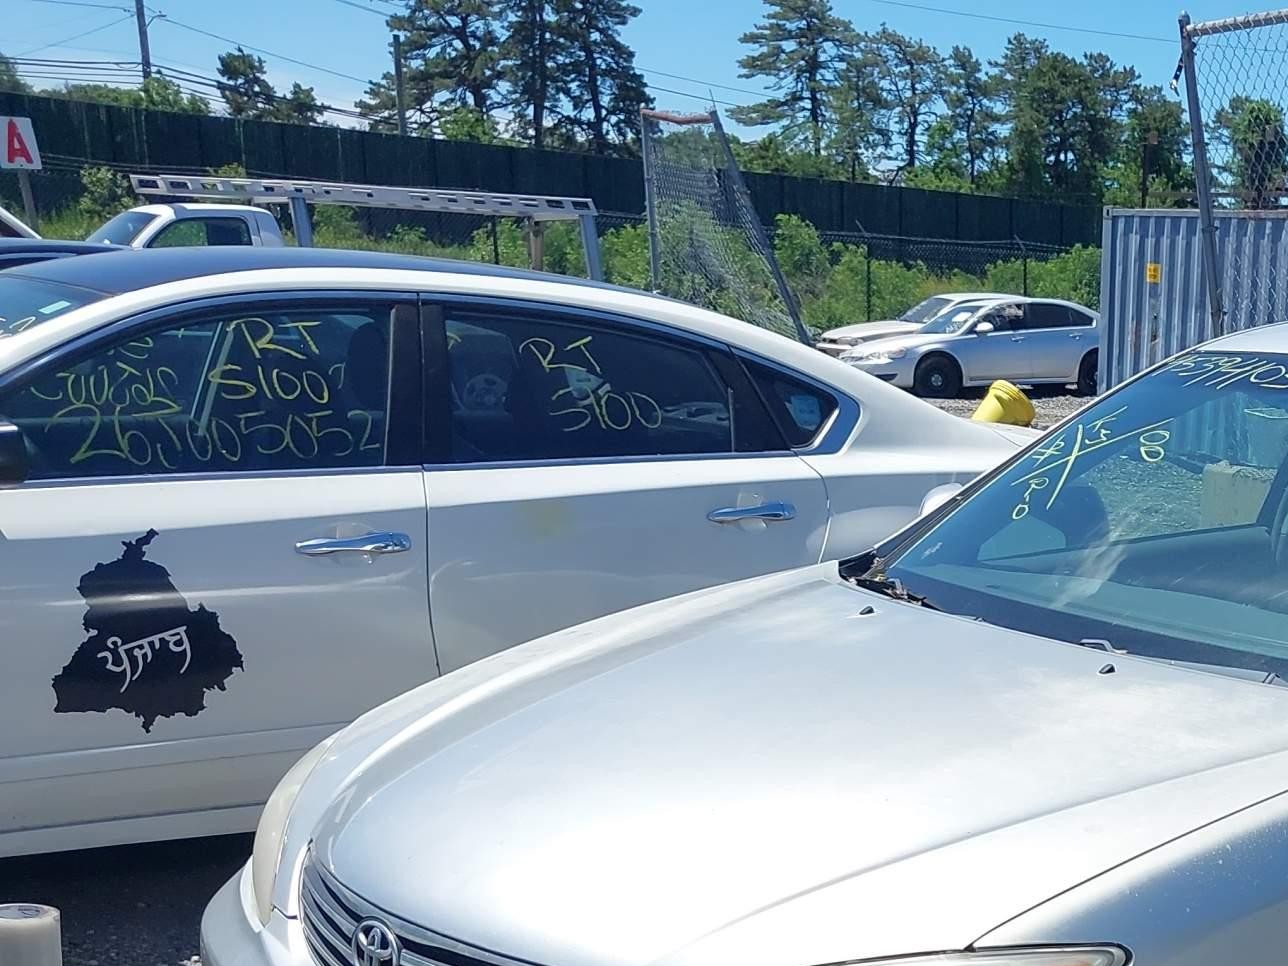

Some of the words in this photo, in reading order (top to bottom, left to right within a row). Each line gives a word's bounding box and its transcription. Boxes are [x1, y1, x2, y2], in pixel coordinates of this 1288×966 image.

[8, 119, 34, 164] A
[227, 318, 321, 359] RT
[520, 335, 602, 373] RT
[97, 625, 192, 694] ਪੰਜਾਬ
